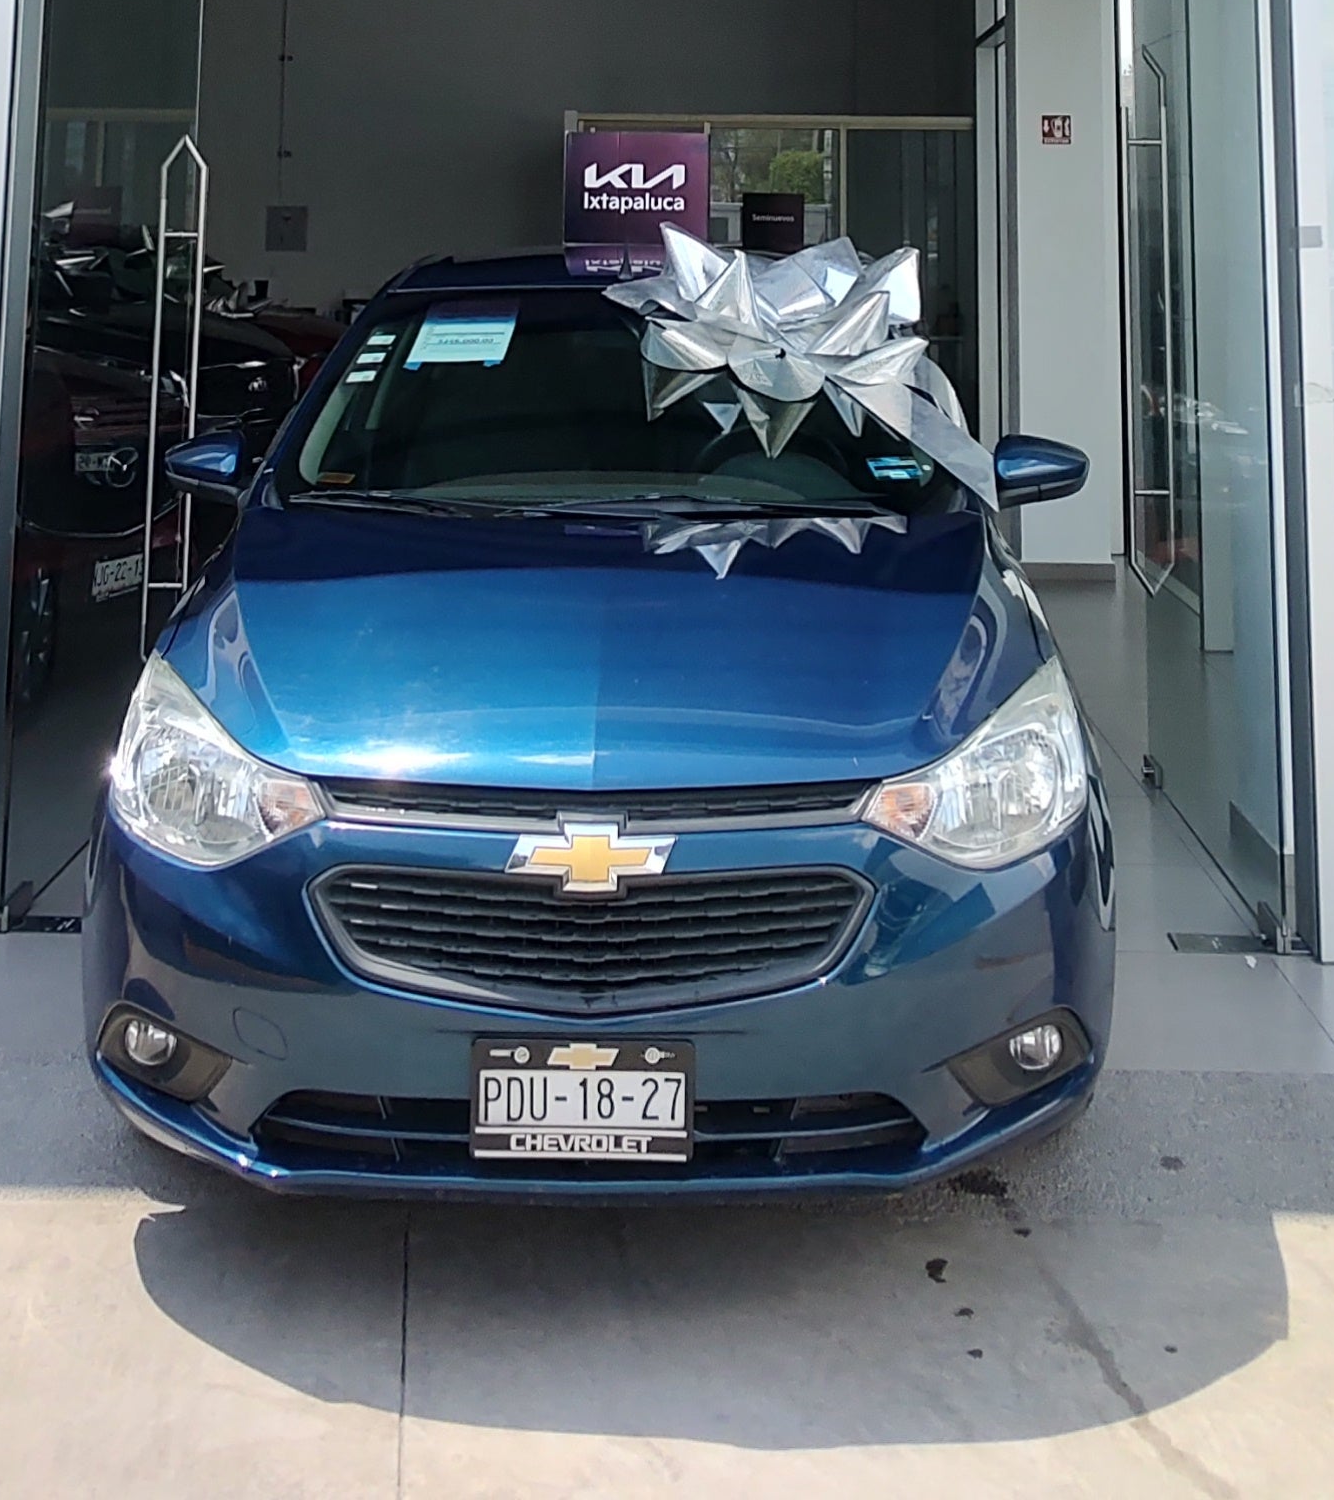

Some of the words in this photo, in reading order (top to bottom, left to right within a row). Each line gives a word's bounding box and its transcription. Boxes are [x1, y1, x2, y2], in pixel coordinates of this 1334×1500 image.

[584, 163, 686, 188] KIA
[583, 191, 685, 213] Ixtapaluca
[752, 213, 795, 222] Seminuevos
[483, 1076, 683, 1122] PDU-18-27
[510, 1134, 652, 1153] CHEVROLET
